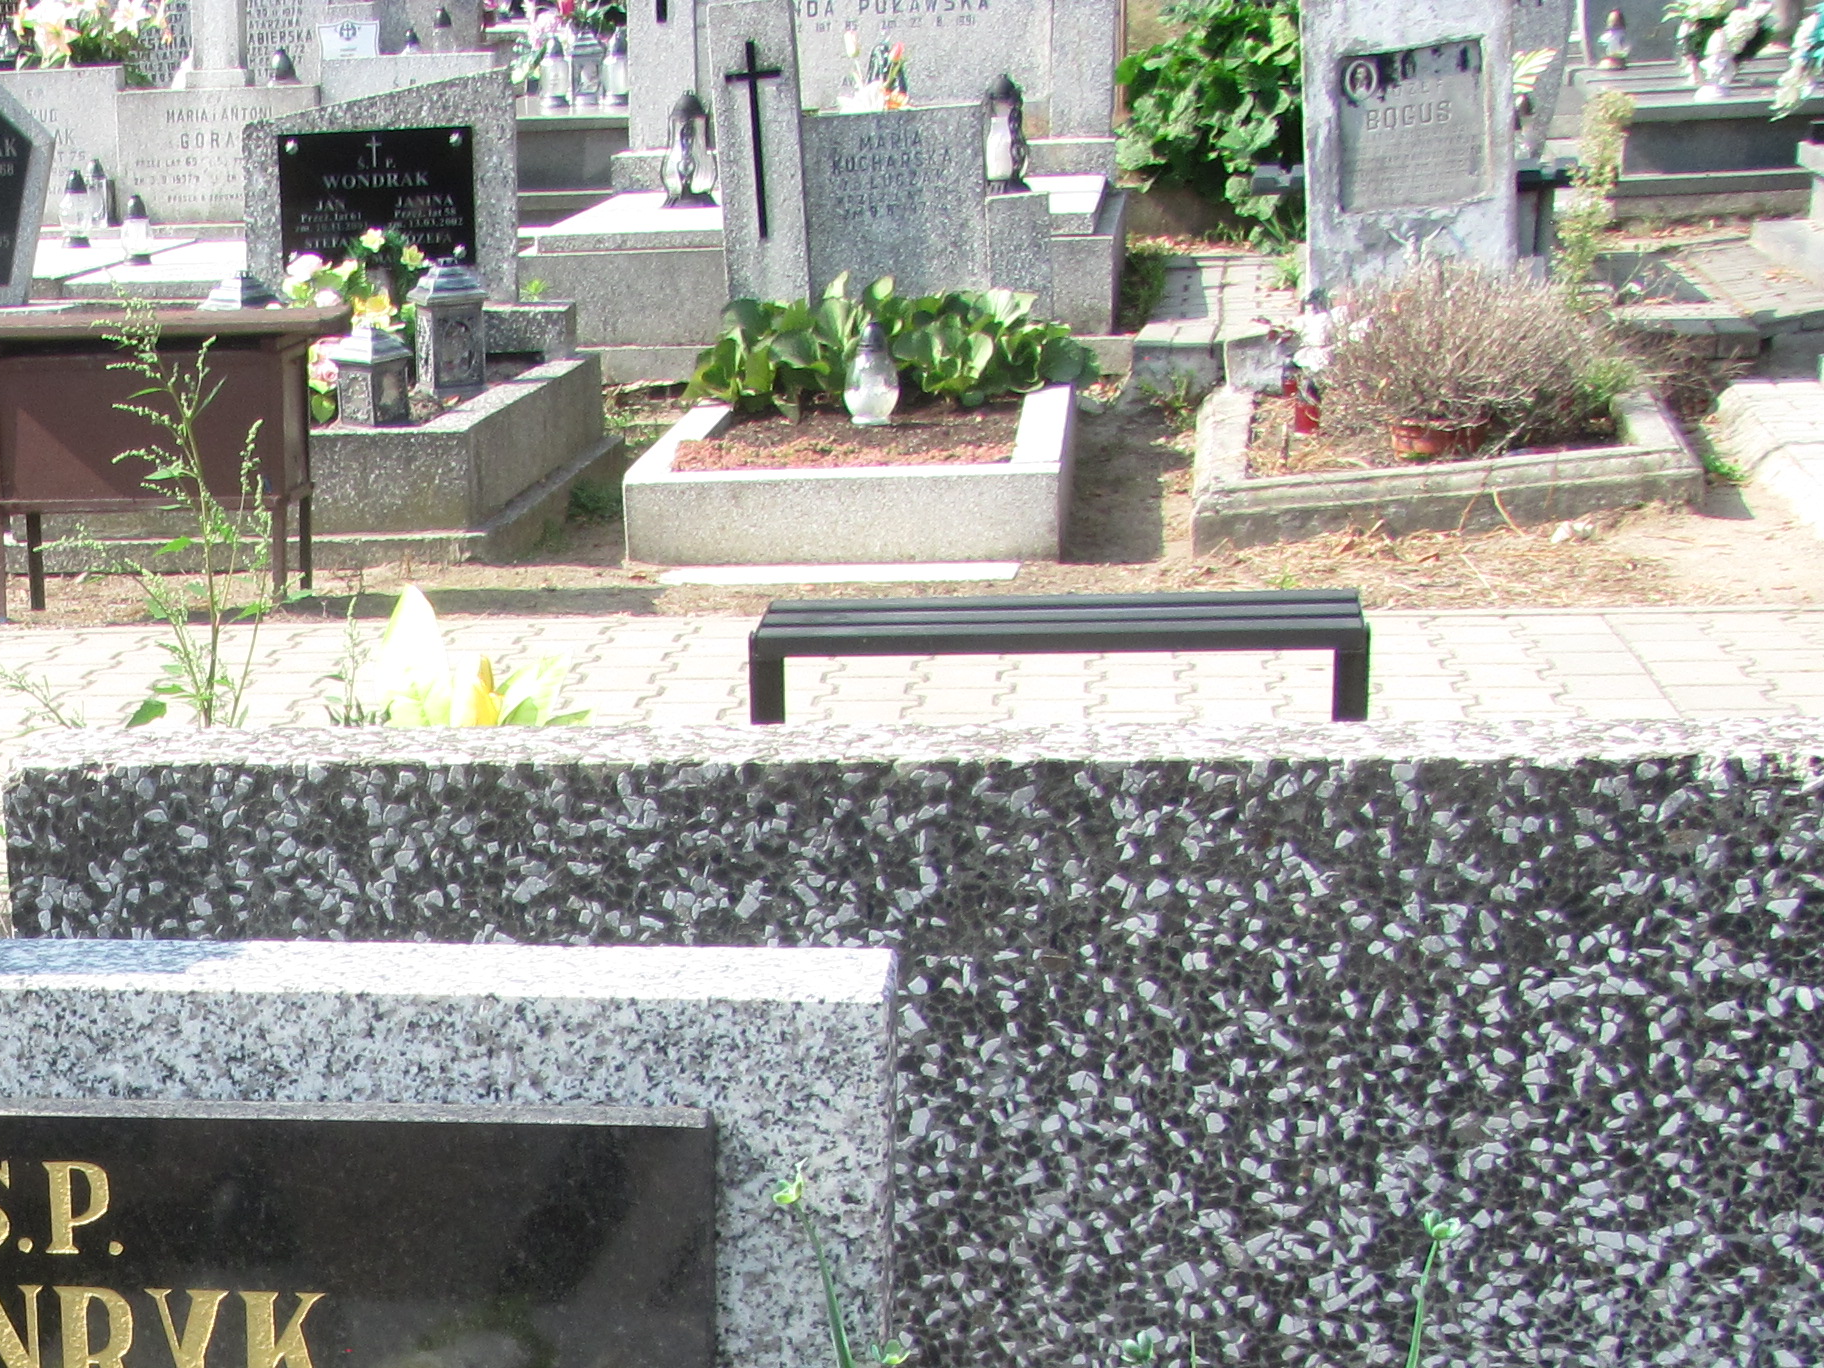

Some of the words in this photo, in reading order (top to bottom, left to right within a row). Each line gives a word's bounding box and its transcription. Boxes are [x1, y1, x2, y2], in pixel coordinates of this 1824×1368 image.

[166, 108, 208, 124] MARIA
[322, 171, 430, 190] WONDRAK
[315, 199, 347, 213] JAN
[395, 193, 455, 209] JANINA
